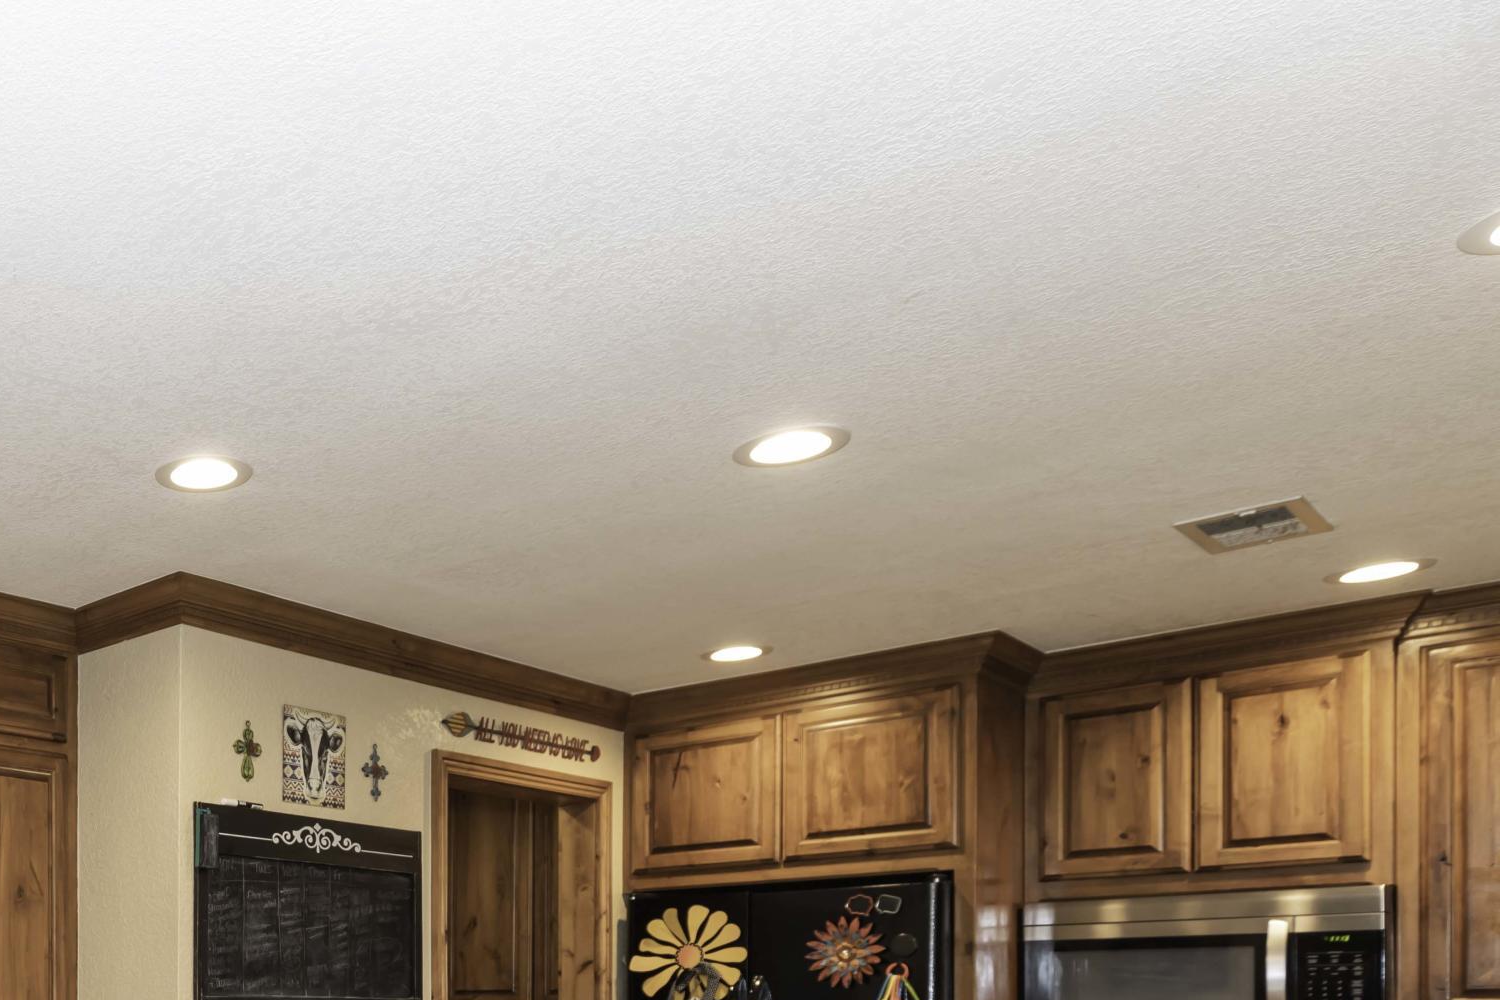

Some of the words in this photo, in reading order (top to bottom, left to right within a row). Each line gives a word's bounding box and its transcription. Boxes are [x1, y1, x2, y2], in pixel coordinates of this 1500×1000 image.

[474, 716, 495, 743] ALL
[499, 721, 522, 748] YOU
[521, 726, 551, 753] NEED
[549, 733, 563, 756] IS
[561, 736, 589, 762] LOVE
